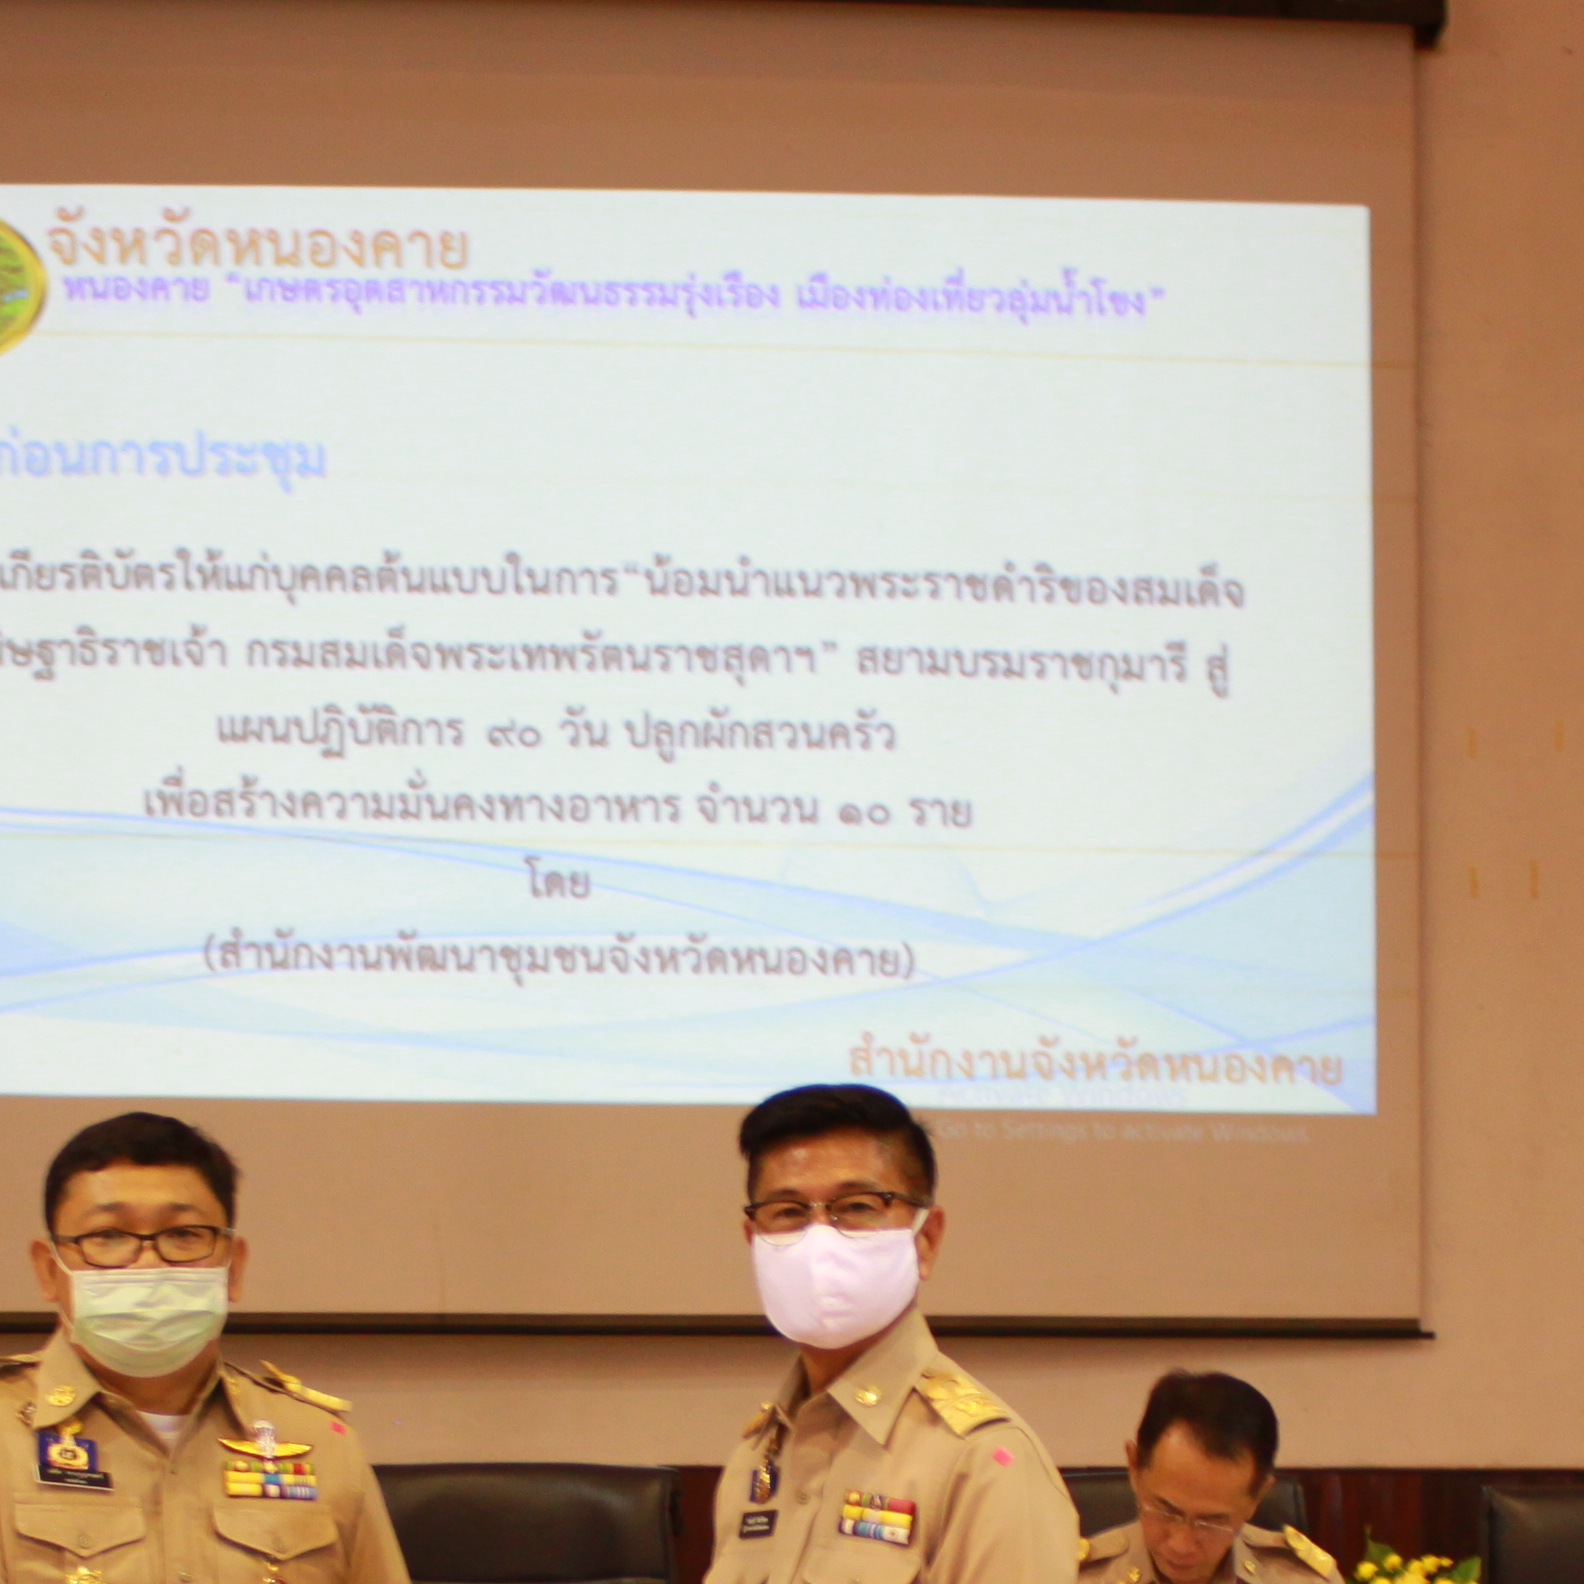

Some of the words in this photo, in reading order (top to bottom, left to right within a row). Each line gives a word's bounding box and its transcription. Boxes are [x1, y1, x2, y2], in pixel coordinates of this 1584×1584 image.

[47, 207, 468, 270] จังหวัดหนองคาย
[62, 275, 210, 303] หนองคาย
[856, 638, 1189, 695] สยามบรมราชกุมารี
[1205, 642, 1230, 699] สู่
[216, 701, 464, 760] แผนปฏิบัติการ
[486, 717, 543, 748] ๙๐
[559, 703, 610, 748] วัน
[622, 704, 898, 764] ปลูกผักสวนครัว
[143, 764, 682, 823] เพื่อสร้างความมั่นคงทางอาหาร
[696, 779, 820, 825] จำนวน
[838, 801, 893, 826] ๑๐
[908, 796, 974, 829] ราย
[524, 855, 592, 899] โดย
[202, 927, 916, 987] (สำนักงานพัฒนาชุมชนจังหวัดหนองคาย)
[847, 1031, 1344, 1086] สำนักงานจังหวัดหนองคาย
